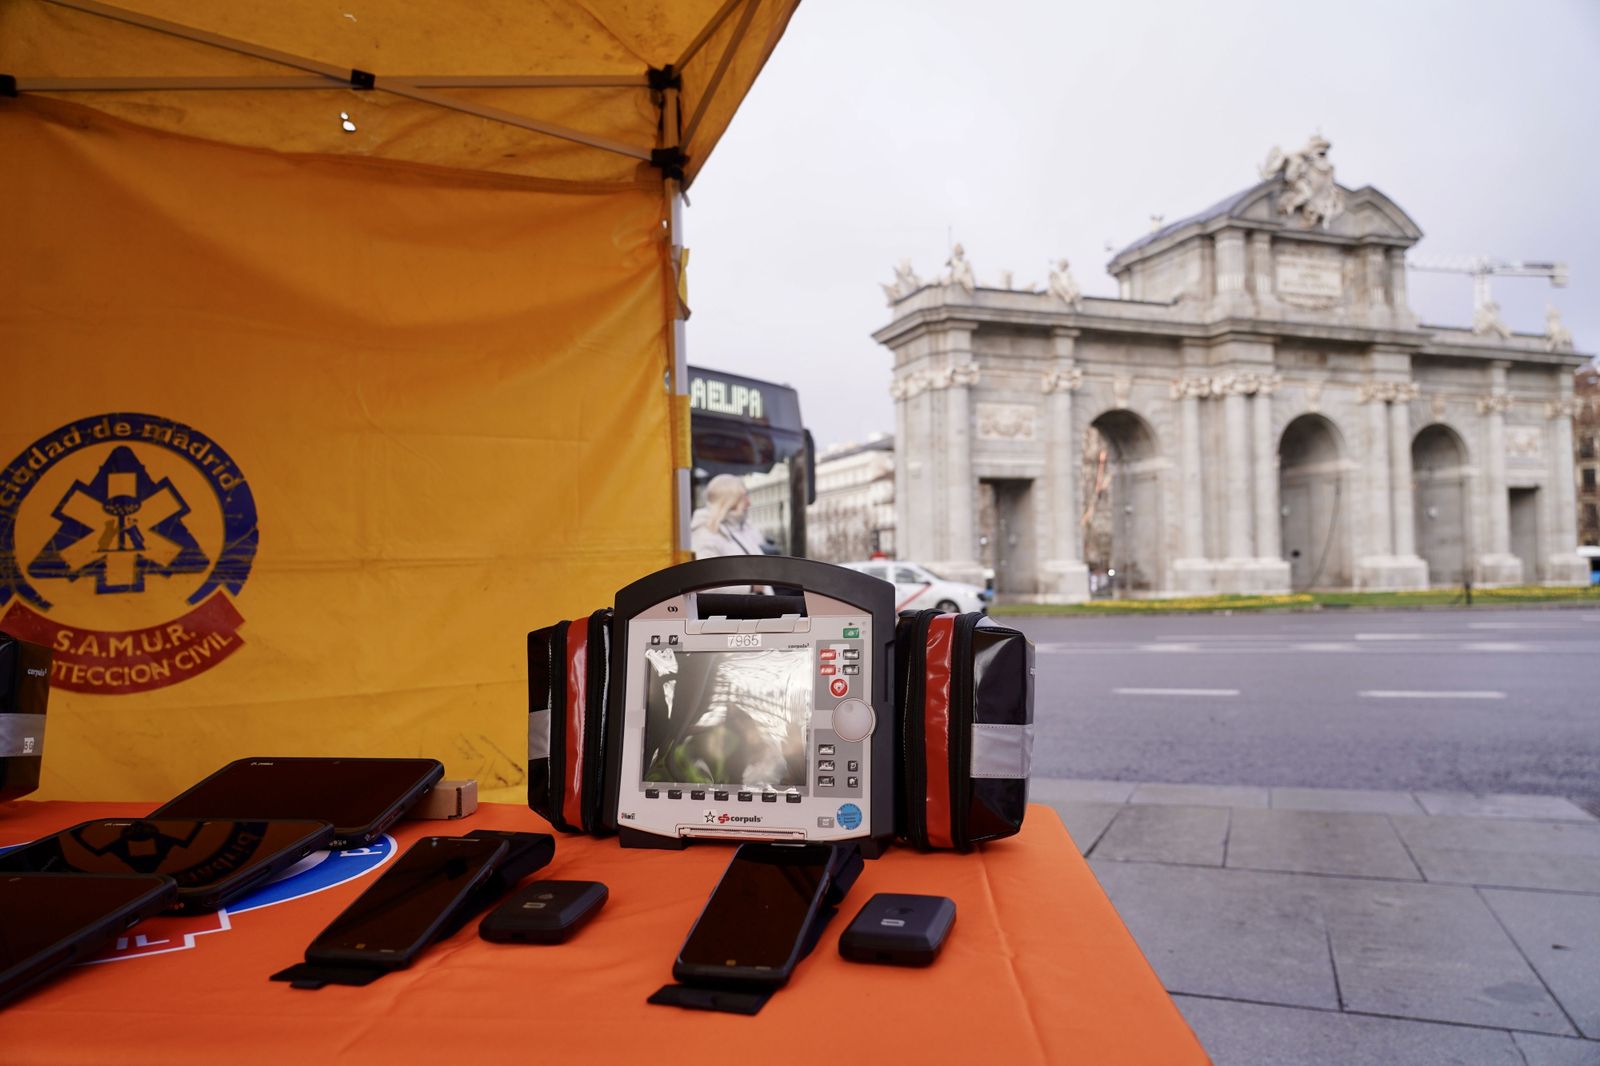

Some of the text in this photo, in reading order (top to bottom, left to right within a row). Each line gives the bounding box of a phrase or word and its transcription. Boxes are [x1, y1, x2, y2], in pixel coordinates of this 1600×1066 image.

[93, 417, 133, 438] de
[53, 623, 197, 658] S.A.M.U.R.
[174, 631, 233, 671] CIVIL
[728, 635, 759, 647] 7965
